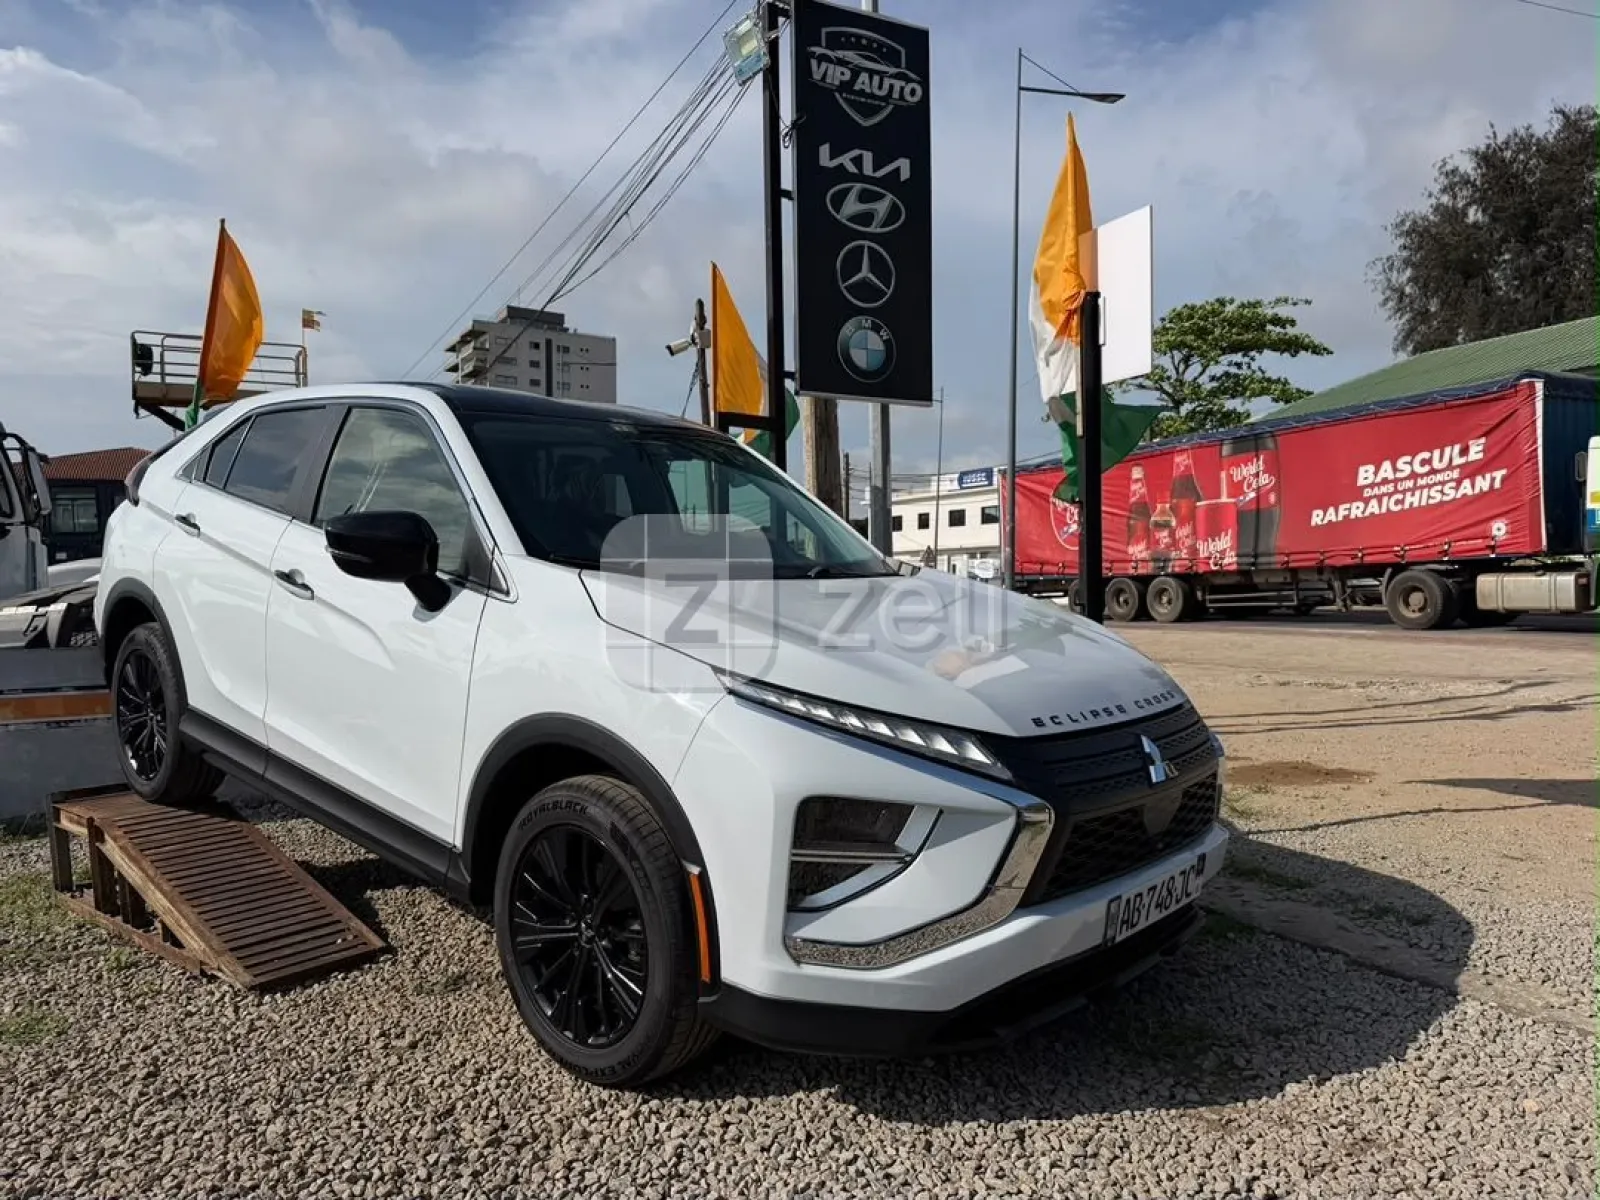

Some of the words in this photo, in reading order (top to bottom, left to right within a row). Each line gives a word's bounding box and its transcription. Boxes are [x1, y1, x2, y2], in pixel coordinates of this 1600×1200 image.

[810, 58, 851, 86] VIP
[853, 72, 923, 103] AUTO
[1229, 454, 1265, 483] World
[1357, 437, 1487, 487] BASCULE
[1310, 469, 1508, 527] RAFRAICHISSANT
[1363, 482, 1395, 498] DANS
[1397, 479, 1414, 491] UN
[1417, 468, 1460, 487] MONDE
[1197, 529, 1232, 558] World
[1031, 704, 1127, 728] ECLIPSE
[1133, 689, 1176, 709] CROSS
